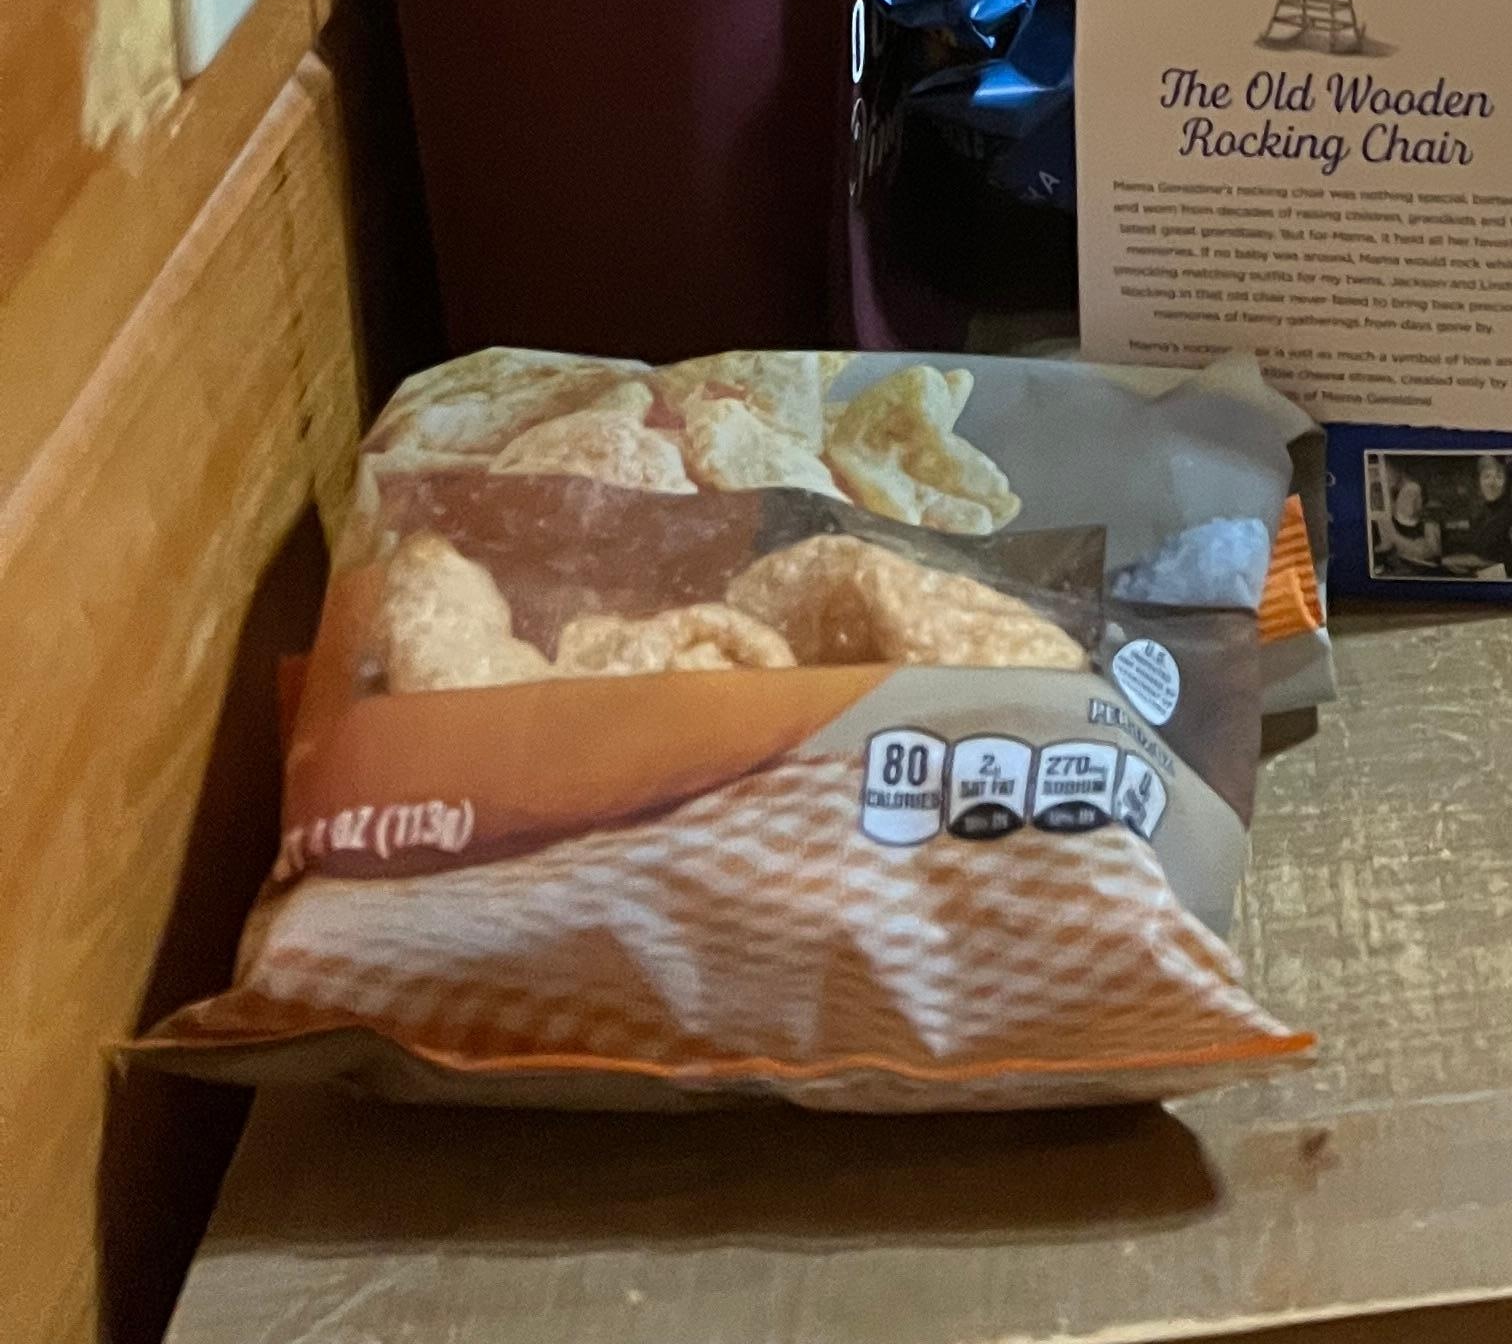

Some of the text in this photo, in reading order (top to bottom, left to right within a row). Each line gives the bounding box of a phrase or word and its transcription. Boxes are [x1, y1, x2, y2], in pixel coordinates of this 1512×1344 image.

[1159, 67, 1495, 118] The Old Wooden
[1178, 117, 1474, 176] Rocking Chair
[1113, 181, 1154, 192] Mama
[1292, 188, 1324, 197] chair
[1331, 191, 1356, 199] was
[1360, 191, 1413, 203] nothing
[1182, 204, 1213, 214] from
[1279, 207, 1292, 218] of
[1481, 216, 1505, 226] and
[1161, 226, 1195, 237] great
[1280, 229, 1304, 240] But
[1310, 229, 1328, 240] for
[1381, 234, 1389, 243] it
[1394, 233, 1424, 244] held
[1448, 235, 1469, 246] her
[1214, 249, 1231, 257] no
[1235, 247, 1267, 261] baby
[1273, 252, 1297, 260] was
[1360, 254, 1399, 264] Mama
[1404, 257, 1446, 267] would
[1450, 258, 1480, 268] rock
[1182, 268, 1245, 282] matching
[1249, 270, 1294, 282] outfits
[1297, 271, 1315, 281] for
[1321, 274, 1340, 286] my
[1450, 279, 1476, 289] and
[1121, 286, 1176, 299] Rocking
[1179, 290, 1192, 298] in
[1195, 289, 1222, 300] that
[1227, 290, 1248, 300] old
[1252, 290, 1284, 302] chair
[1372, 297, 1387, 307] to
[1391, 298, 1428, 311] bring
[1432, 299, 1464, 310] back
[1224, 311, 1240, 322] of
[1364, 317, 1396, 328] from
[1401, 319, 1432, 331] days
[1436, 322, 1472, 332] gone
[1129, 340, 1179, 352] Mama's
[1337, 350, 1375, 360] much
[1392, 353, 1440, 364] symbol
[1445, 354, 1459, 365] of
[1463, 355, 1491, 366] love
[1457, 377, 1484, 389] only
[1489, 377, 1506, 389] by
[1303, 390, 1317, 401] of
[1321, 388, 1362, 403] Mama
[883, 744, 928, 786] 80
[865, 789, 940, 809] CALORIES
[991, 780, 1015, 796] FAT
[1043, 780, 1107, 795] SODIUM
[330, 805, 375, 851] OZ
[374, 798, 475, 859] (113g)
